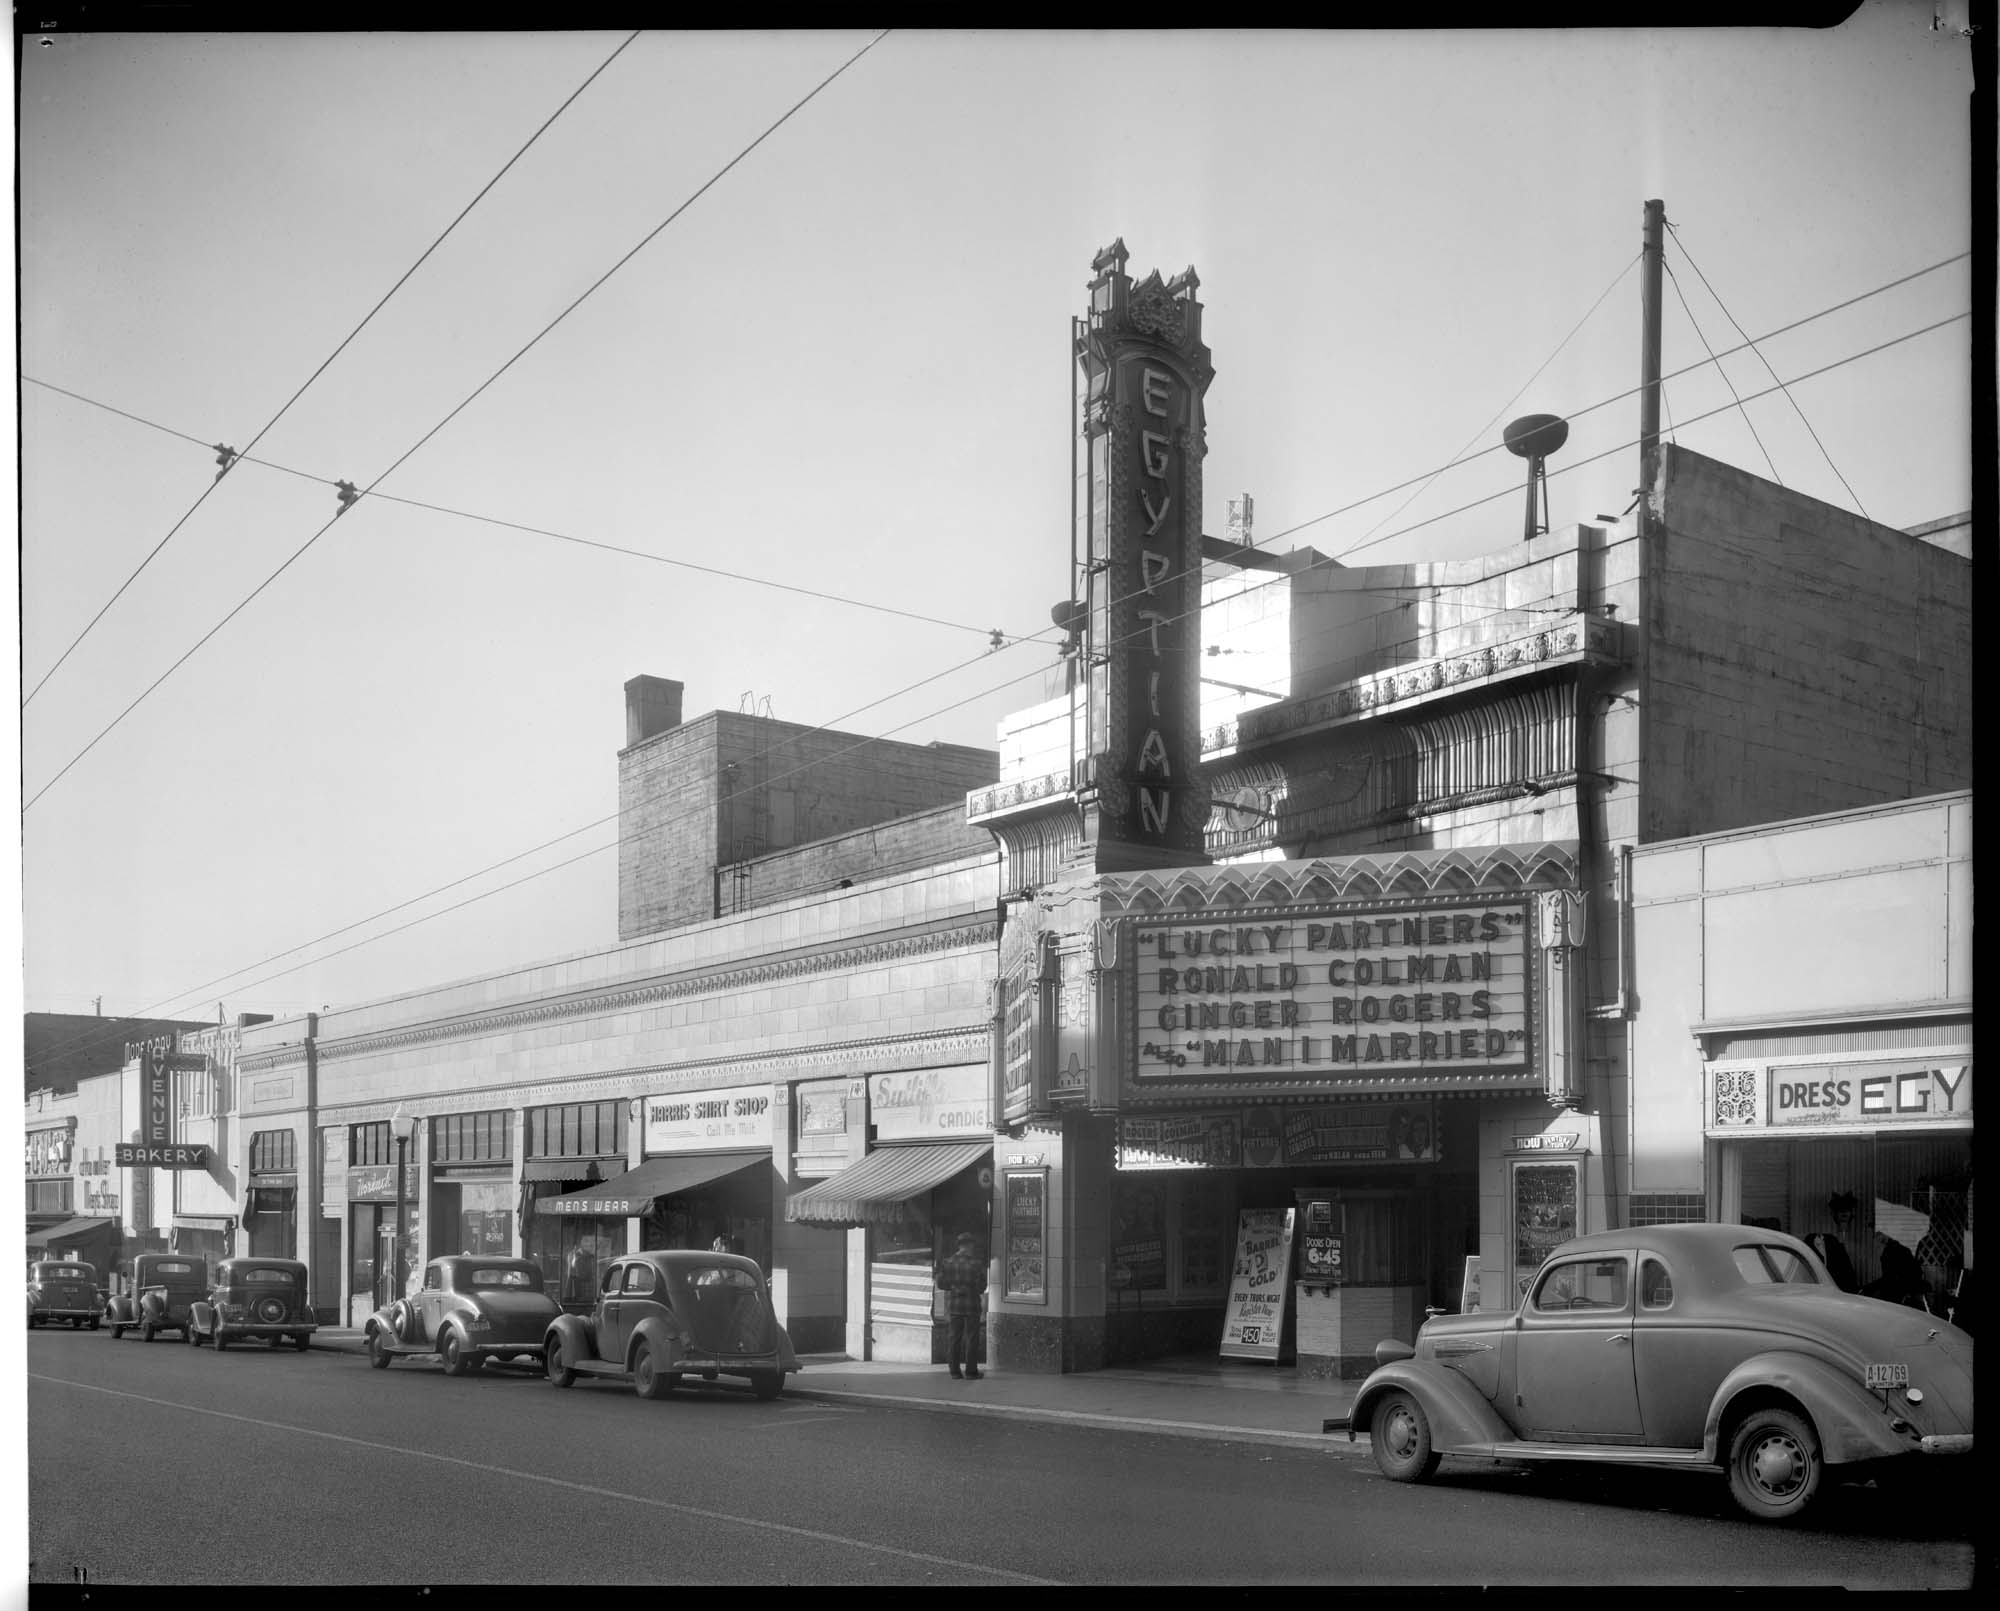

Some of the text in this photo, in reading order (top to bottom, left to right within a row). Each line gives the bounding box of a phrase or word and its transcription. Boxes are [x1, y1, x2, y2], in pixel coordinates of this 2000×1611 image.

[1137, 366, 1172, 833] EGYPTIAN
[1158, 951, 1491, 996] RONALD COLMAN
[1157, 989, 1492, 1032] GINGER ROGERS
[1143, 1041, 1187, 1068] ALSO
[1301, 1035, 1311, 1065] I
[151, 1047, 166, 1141] AVENUE
[1778, 1080, 1851, 1109] DRESS
[1860, 1065, 1969, 1115] EGY
[649, 1096, 769, 1125] HARRIS SHIRT SHOP
[122, 1148, 203, 1162] BAKERY
[555, 1200, 630, 1213] MEN'S WEAR
[1244, 1237, 1281, 1257] BARREL
[1306, 1236, 1341, 1249] DOORS OPEN
[1307, 1248, 1341, 1265] 6:45
[1249, 1270, 1277, 1288] GOLD
